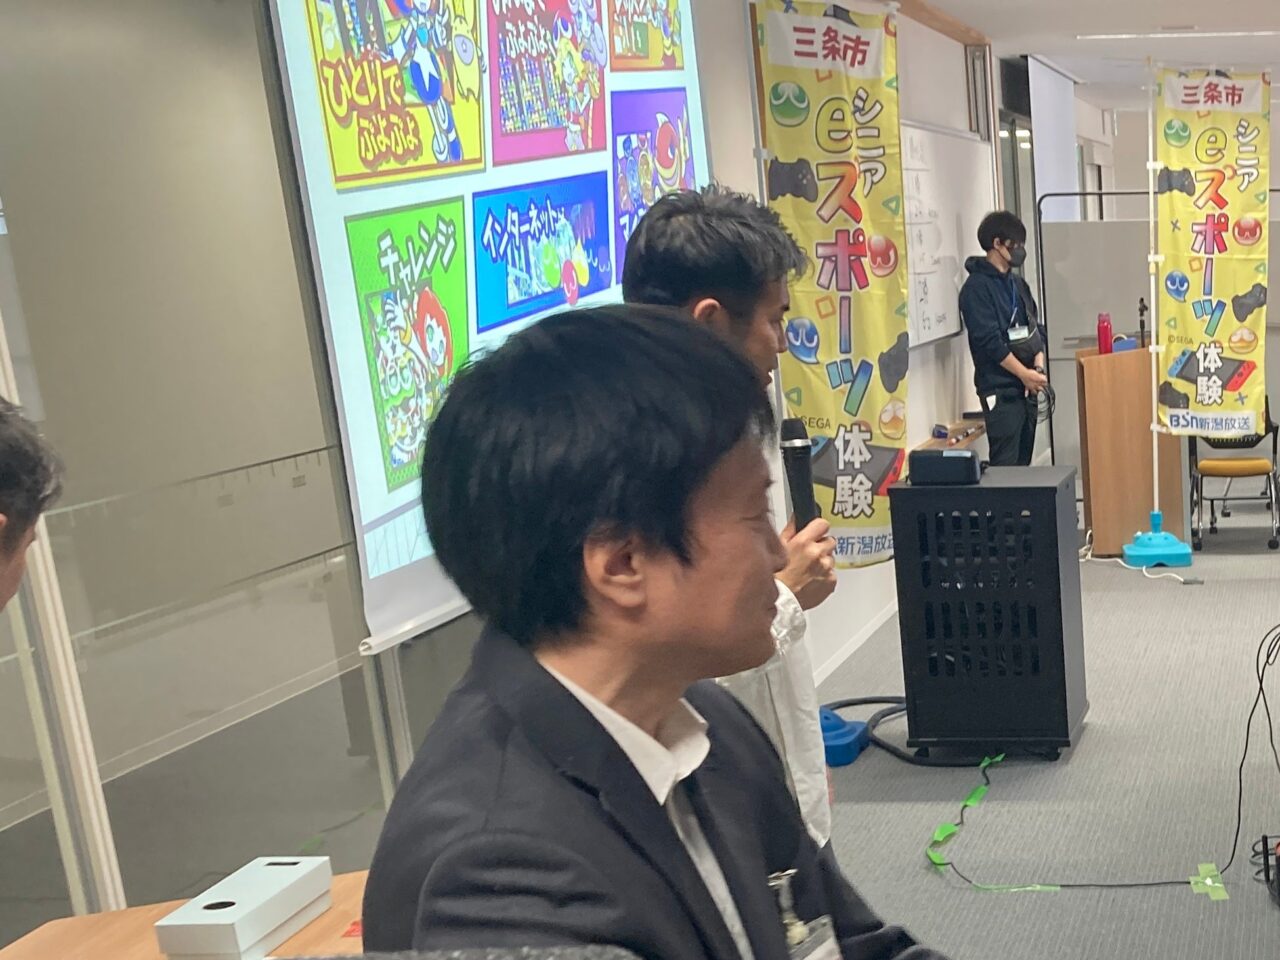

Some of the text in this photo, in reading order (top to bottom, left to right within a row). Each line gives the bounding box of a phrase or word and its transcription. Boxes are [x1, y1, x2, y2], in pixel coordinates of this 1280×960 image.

[793, 25, 870, 68] 三条市
[322, 57, 402, 118] ひとりで
[1181, 82, 1244, 107] 三条市
[359, 113, 419, 161] ぷよぷよ
[852, 86, 887, 199] シニア
[1235, 118, 1260, 193] シニア
[379, 219, 456, 296] チャレンジ
